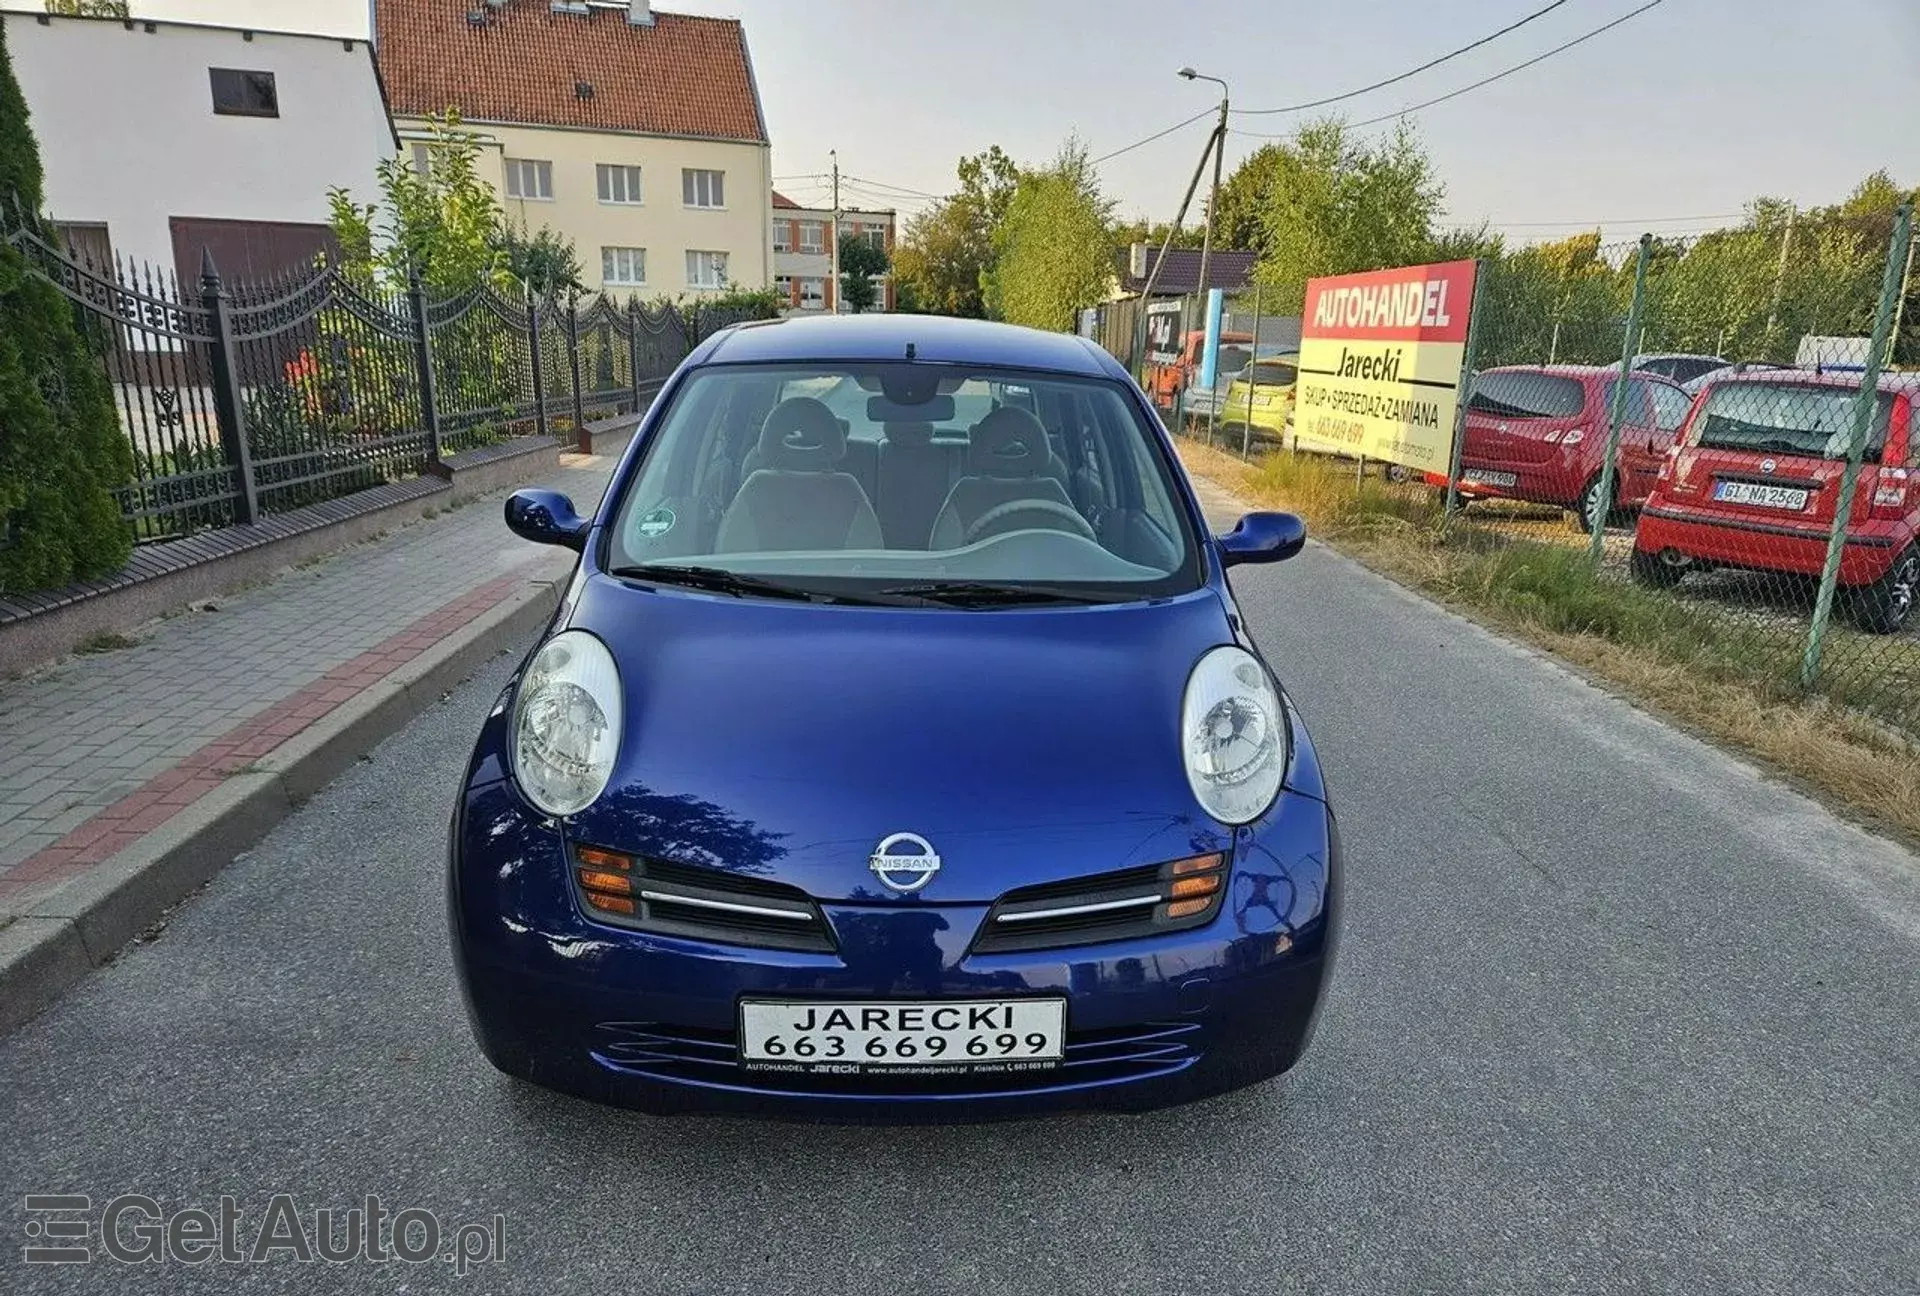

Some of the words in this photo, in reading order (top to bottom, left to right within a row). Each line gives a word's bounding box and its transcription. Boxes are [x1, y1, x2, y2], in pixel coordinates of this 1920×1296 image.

[1314, 280, 1450, 328] AUTOHANDEL
[1336, 347, 1402, 383] Jarecki
[1385, 398, 1439, 429] ZAMIANA
[879, 858, 933, 868] NISSAN
[793, 1006, 1014, 1032] JARECKI
[764, 1035, 846, 1057] 663
[864, 1035, 947, 1058] 669
[965, 1033, 1048, 1057] 699
[745, 1063, 805, 1072] AUTOHANDEL
[810, 1064, 861, 1074] Jarecki
